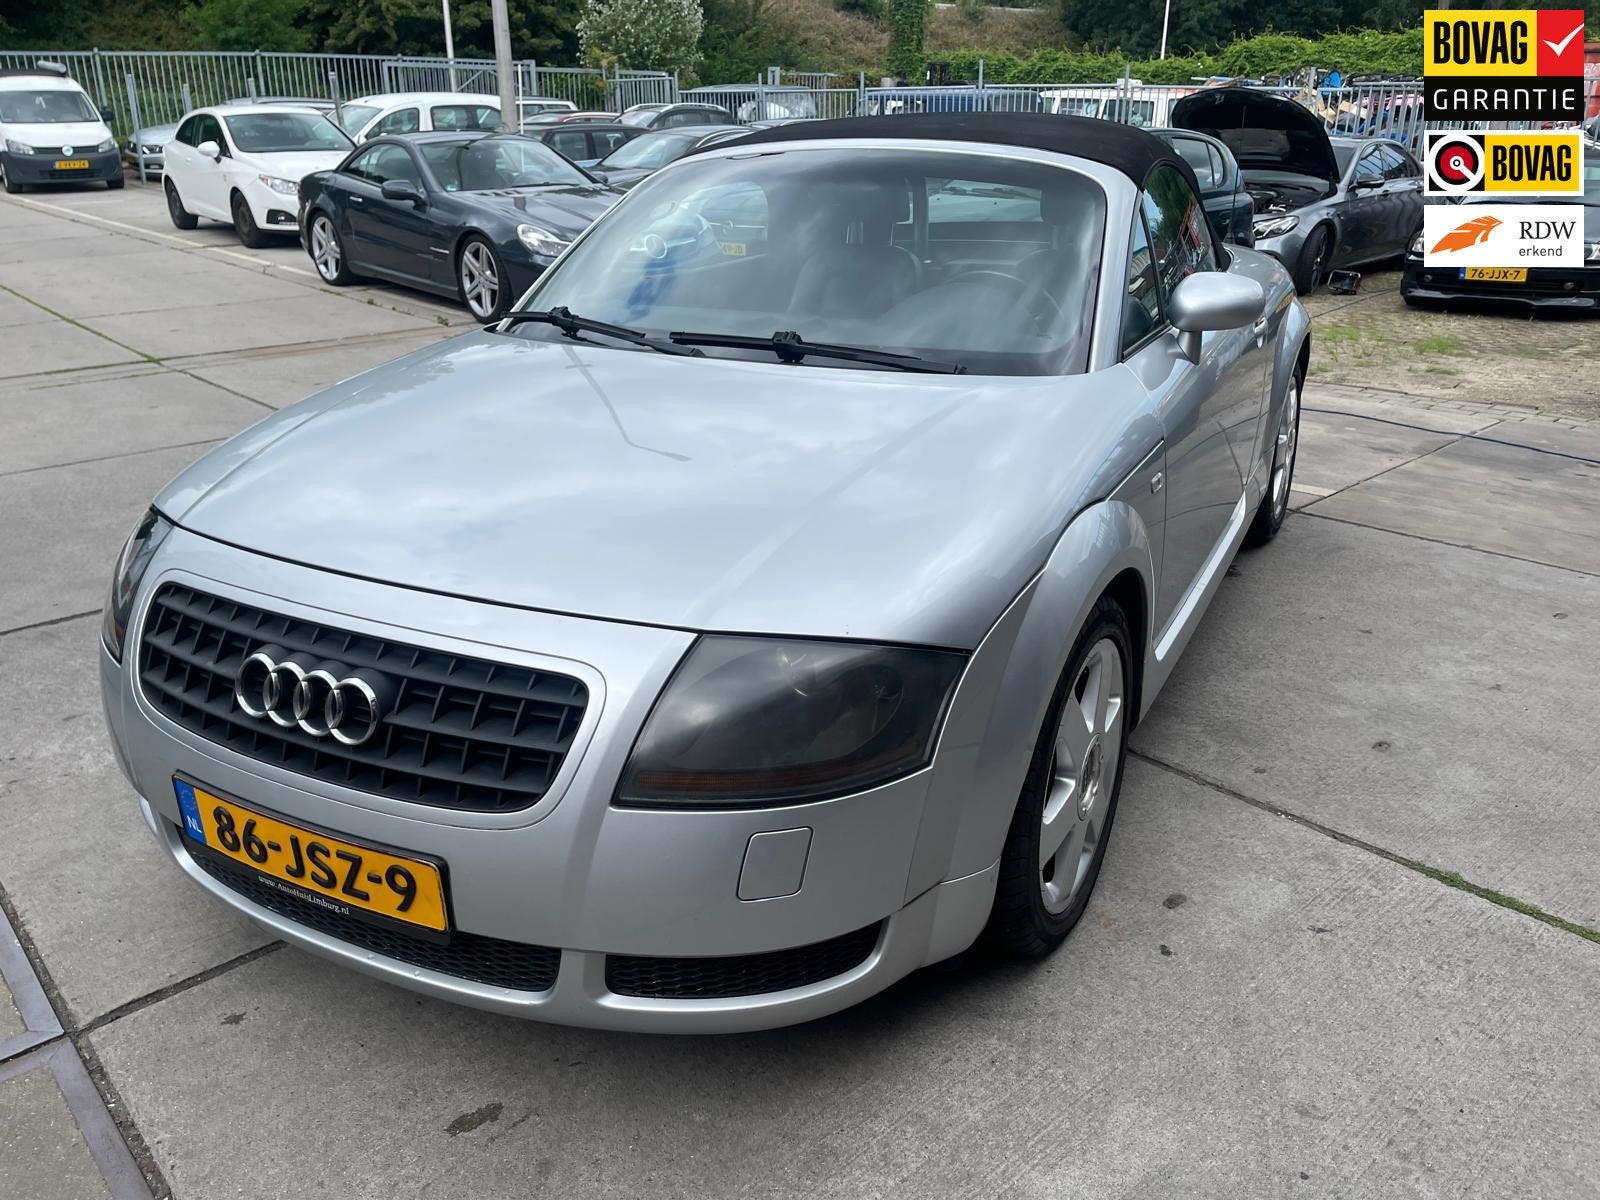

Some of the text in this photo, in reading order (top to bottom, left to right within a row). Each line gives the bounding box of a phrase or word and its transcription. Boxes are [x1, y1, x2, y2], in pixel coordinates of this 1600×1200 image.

[1471, 268, 1521, 281] 76-JJX-7
[186, 805, 417, 913] NL 86-JSZ-9
